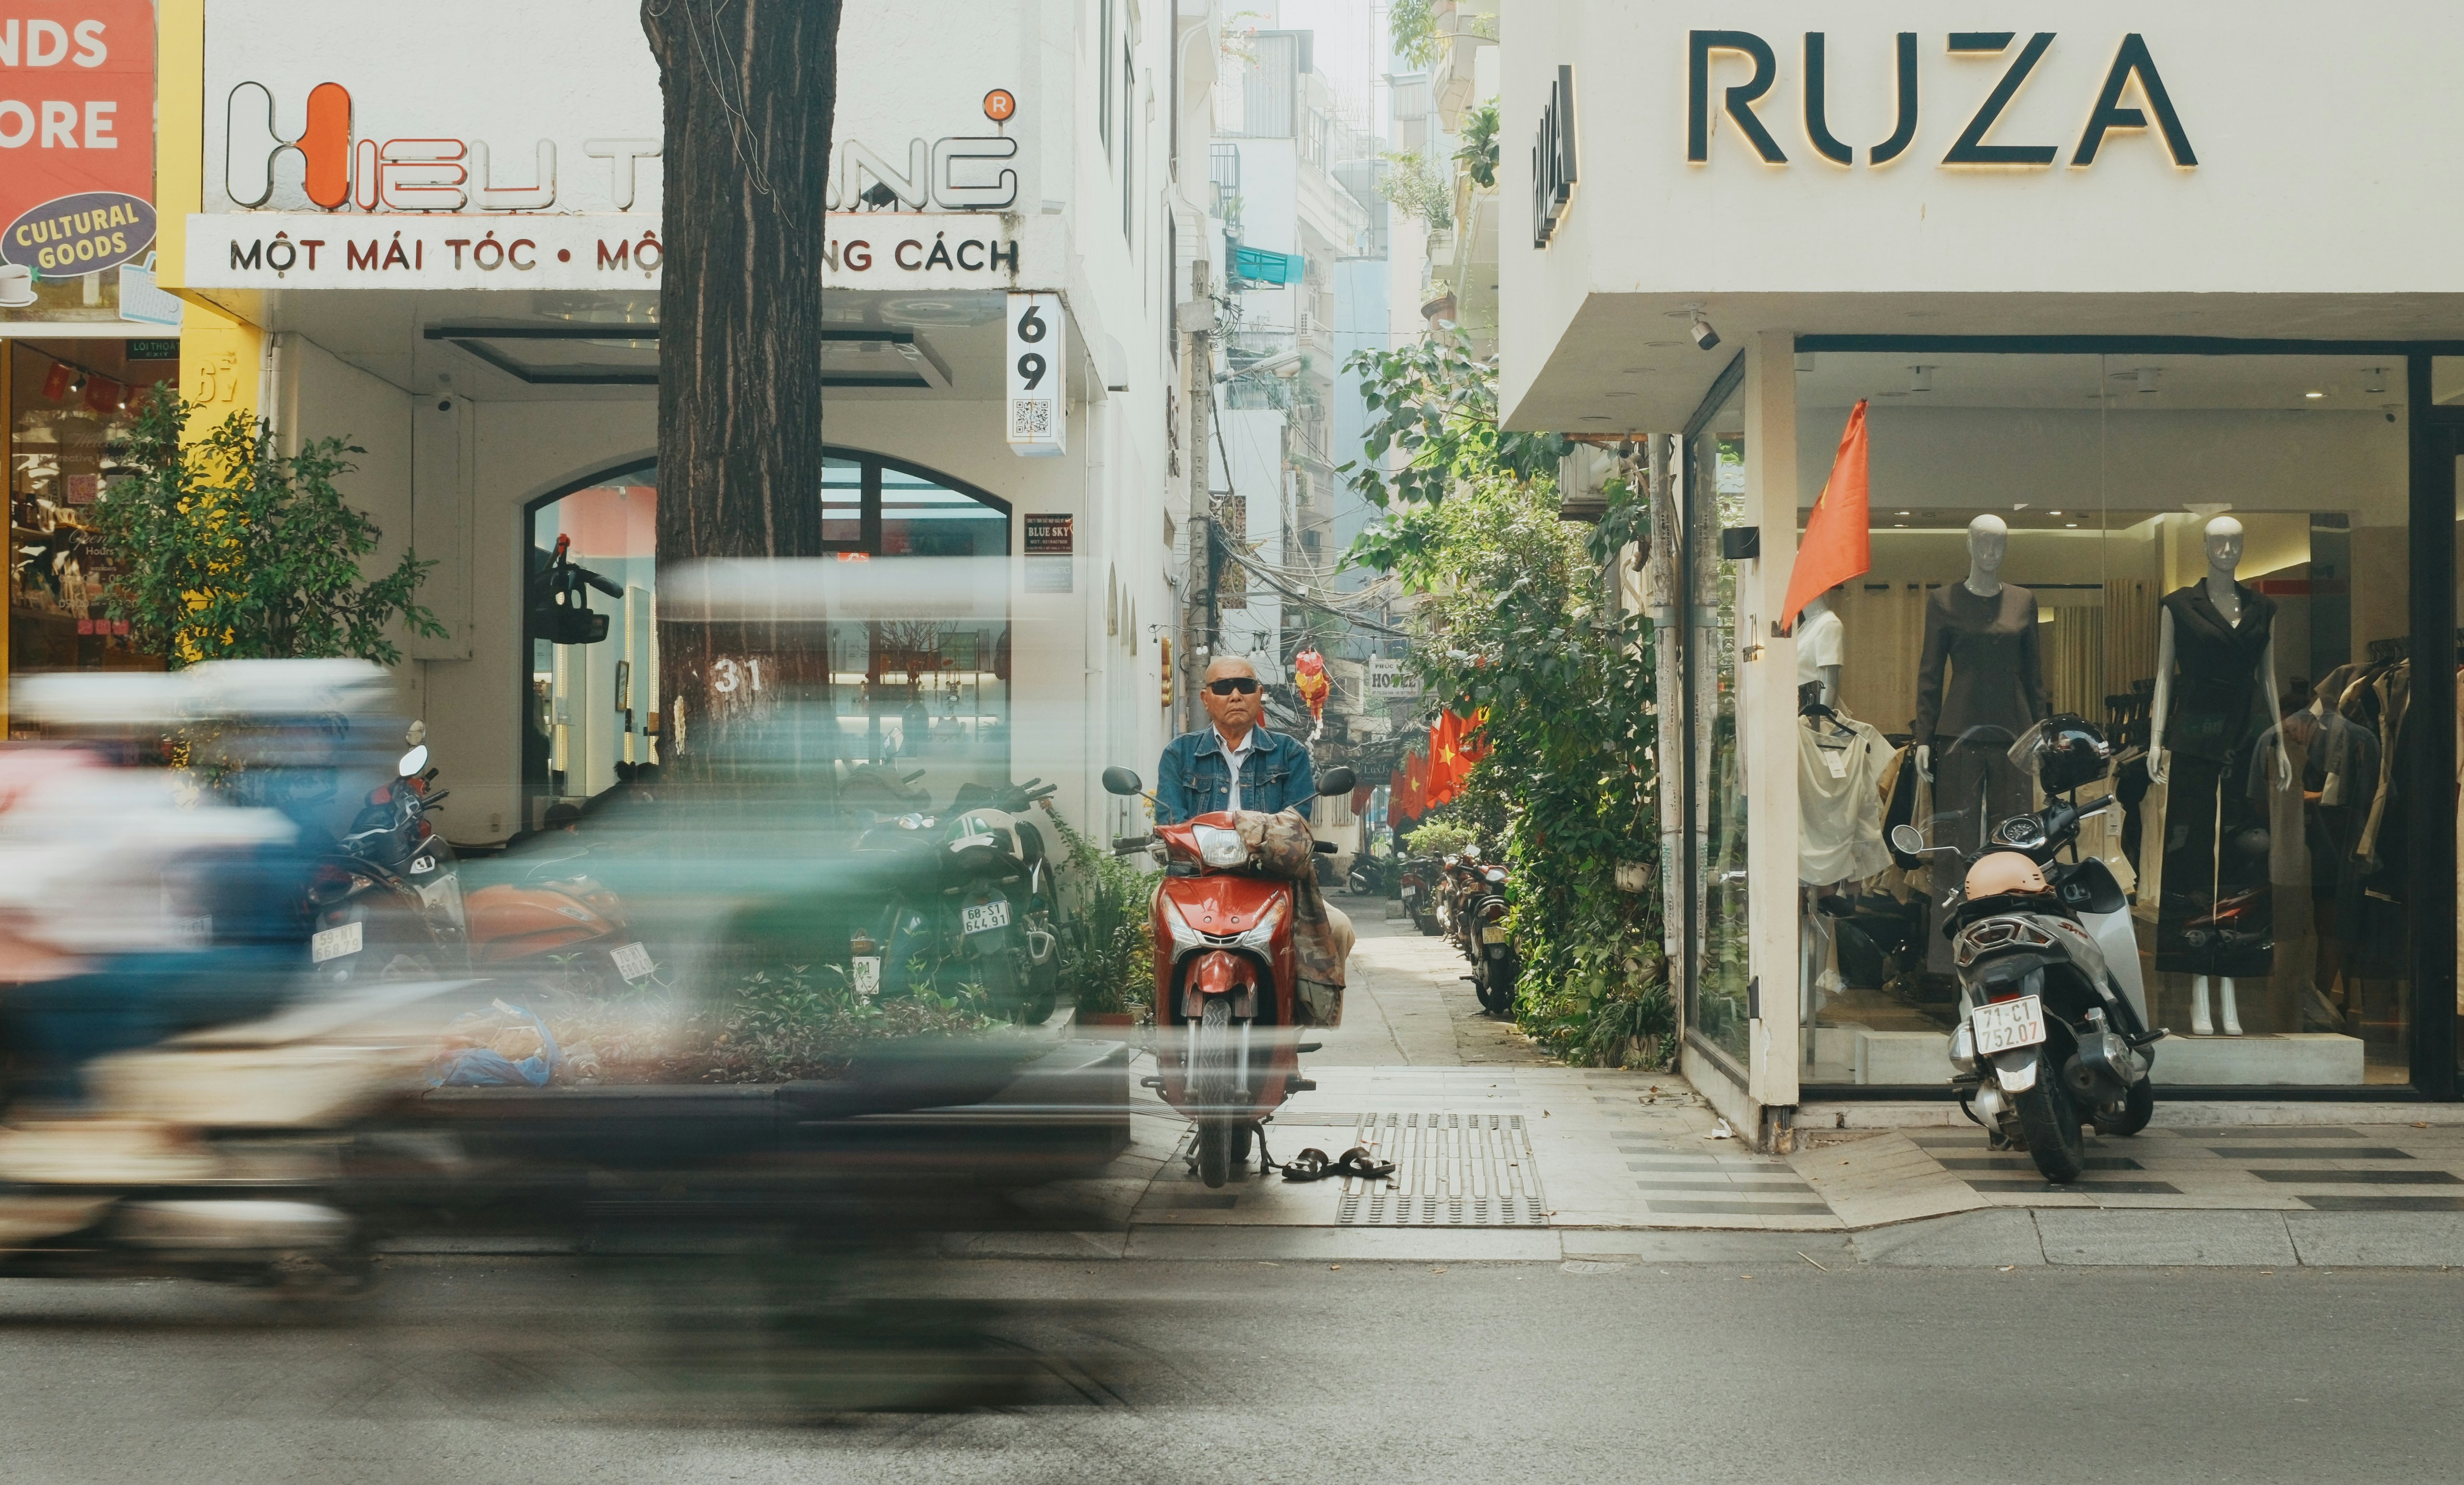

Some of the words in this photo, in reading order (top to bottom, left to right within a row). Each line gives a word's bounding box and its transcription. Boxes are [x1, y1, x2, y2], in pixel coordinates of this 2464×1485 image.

[1688, 30, 2199, 166] RUZA
[16, 203, 139, 246] CULTURAL
[38, 232, 127, 269] GOODS
[230, 231, 325, 279] MỘT
[348, 231, 422, 271] MÁI
[446, 230, 536, 271] TÓC
[597, 230, 663, 279] MỘ
[895, 231, 1019, 272] CÁCH
[1028, 527, 1051, 537] BLUE
[1052, 527, 1070, 537] SKY
[86, 546, 114, 555] Hours
[715, 658, 762, 692] 31
[966, 914, 1005, 932] 644.91
[968, 904, 1000, 920] 68-S1
[316, 938, 359, 960] 668.79
[1983, 1001, 2029, 1028] 71-C1
[1982, 1022, 2038, 1050] 752.07
